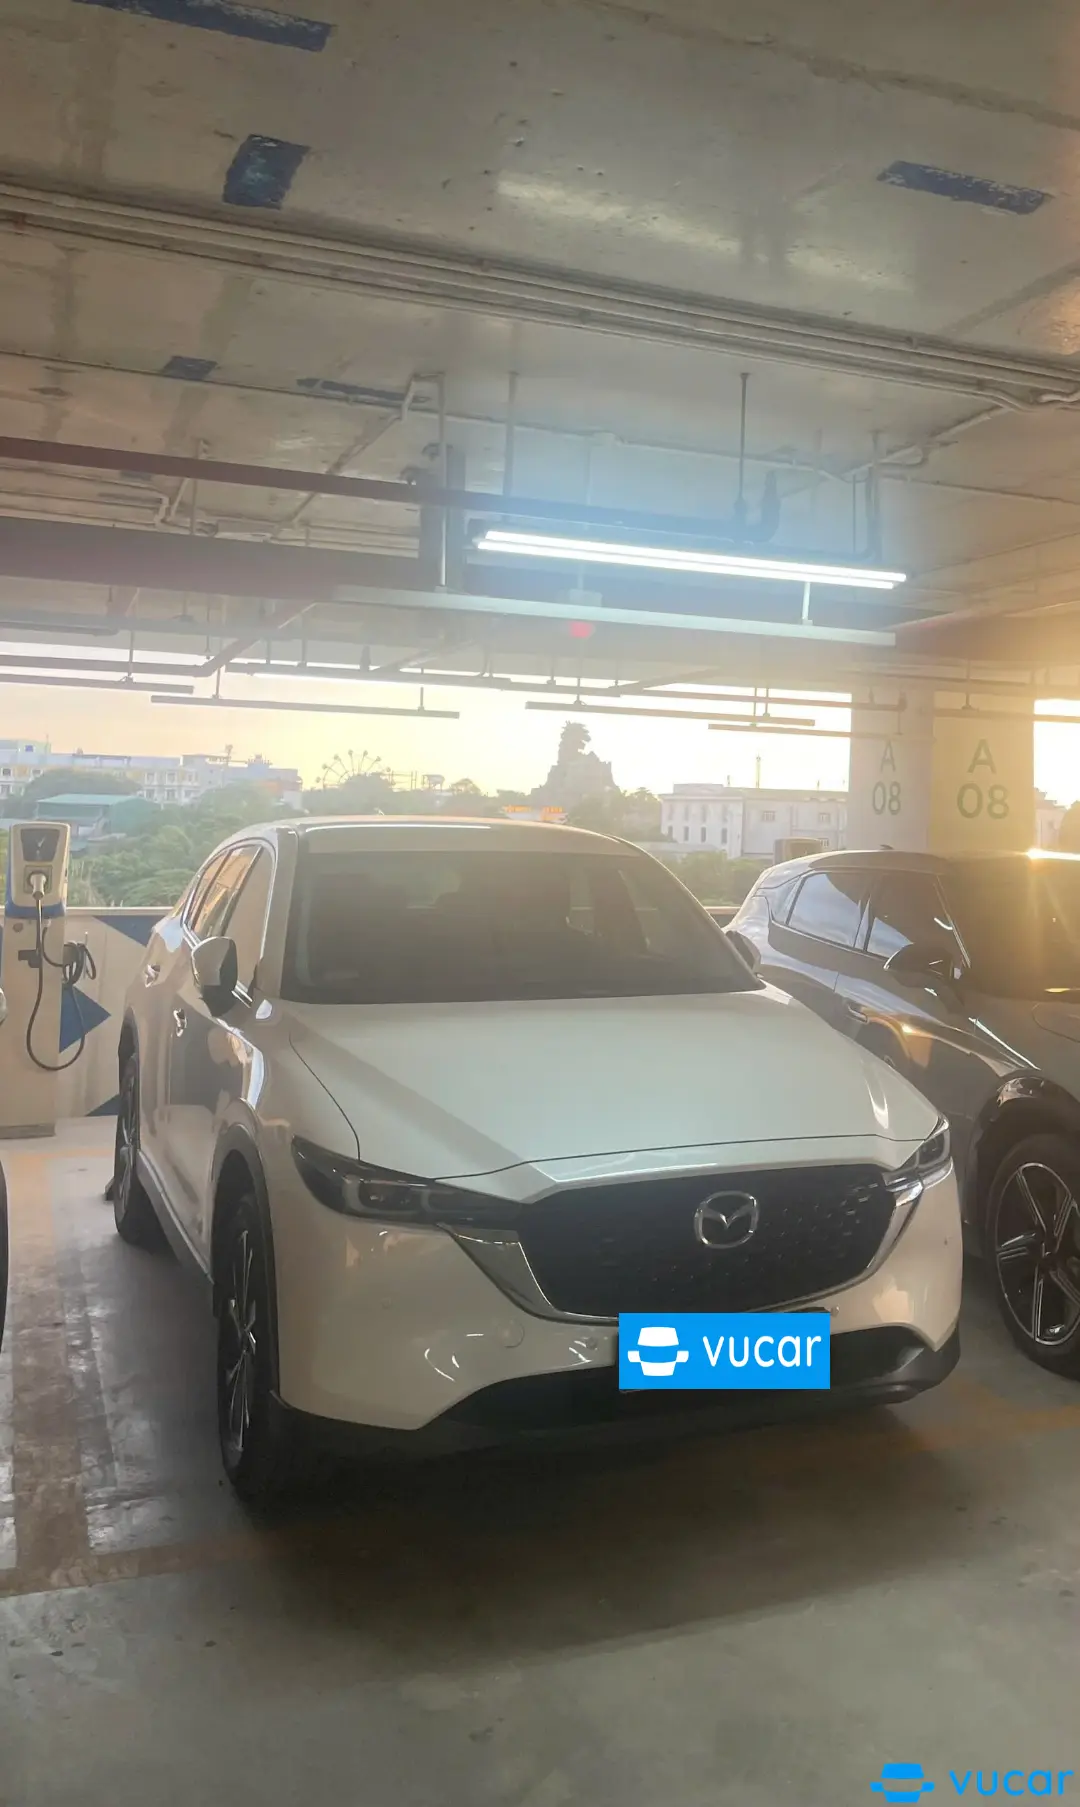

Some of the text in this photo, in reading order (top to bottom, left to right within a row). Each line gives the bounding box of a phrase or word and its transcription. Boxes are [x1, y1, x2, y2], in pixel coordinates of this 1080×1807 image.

[880, 739, 897, 773] A
[966, 738, 997, 774] A
[872, 781, 902, 816] 08
[956, 782, 1010, 819] 08
